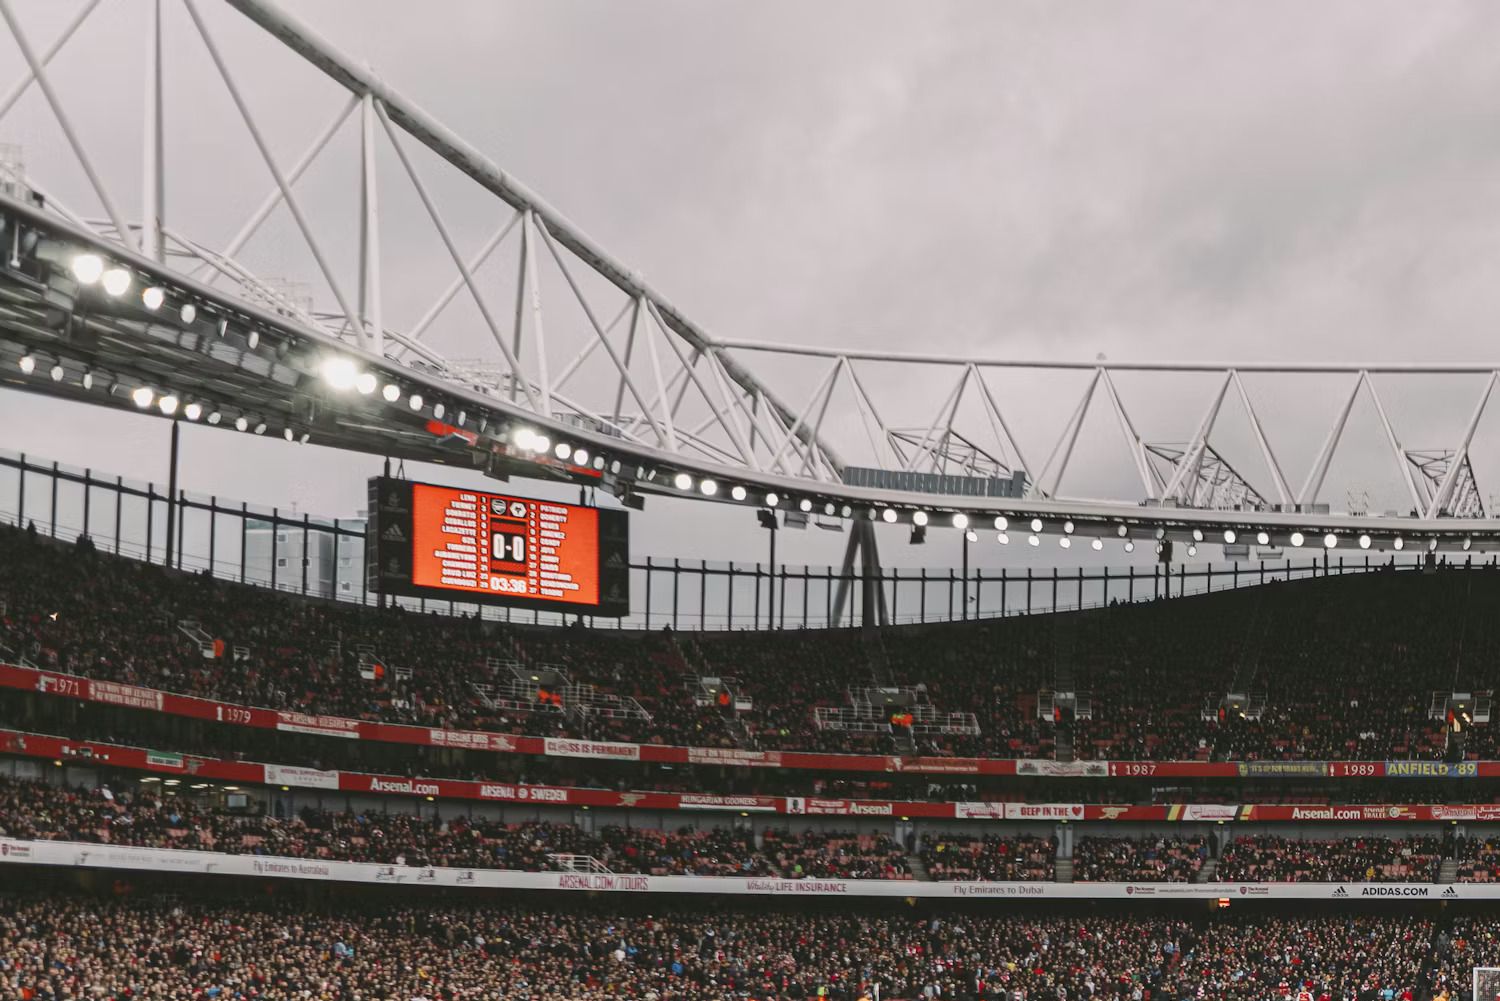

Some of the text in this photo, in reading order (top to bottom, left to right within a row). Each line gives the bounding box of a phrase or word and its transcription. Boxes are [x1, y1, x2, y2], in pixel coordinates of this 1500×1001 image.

[490, 577, 527, 593] 03:36
[53, 680, 79, 695] 1971
[228, 708, 251, 723] 1979
[547, 740, 637, 757] CLSS IS PERMANENT
[1125, 765, 1156, 776] 1987
[1343, 765, 1375, 776] 1989
[1387, 764, 1449, 776] ANFIELD
[370, 777, 439, 795] Arsenal.com
[480, 785, 567, 801] ARSENAL SWEDEN
[681, 794, 757, 805] HUNGARIAN GOONERS
[850, 803, 893, 815] Arsenal
[1042, 807, 1051, 816] IN
[1053, 807, 1069, 816] THE
[1292, 808, 1361, 819] Arsenal.com
[559, 875, 648, 891] ARSENAL.COM/TOURS
[776, 882, 793, 891] LIFE
[796, 883, 847, 892] INSURANCE
[954, 886, 966, 895] Fly
[969, 886, 1005, 894] Emirates
[1019, 886, 1044, 895] Dubai
[1362, 887, 1428, 896] ADIDAS.COM
